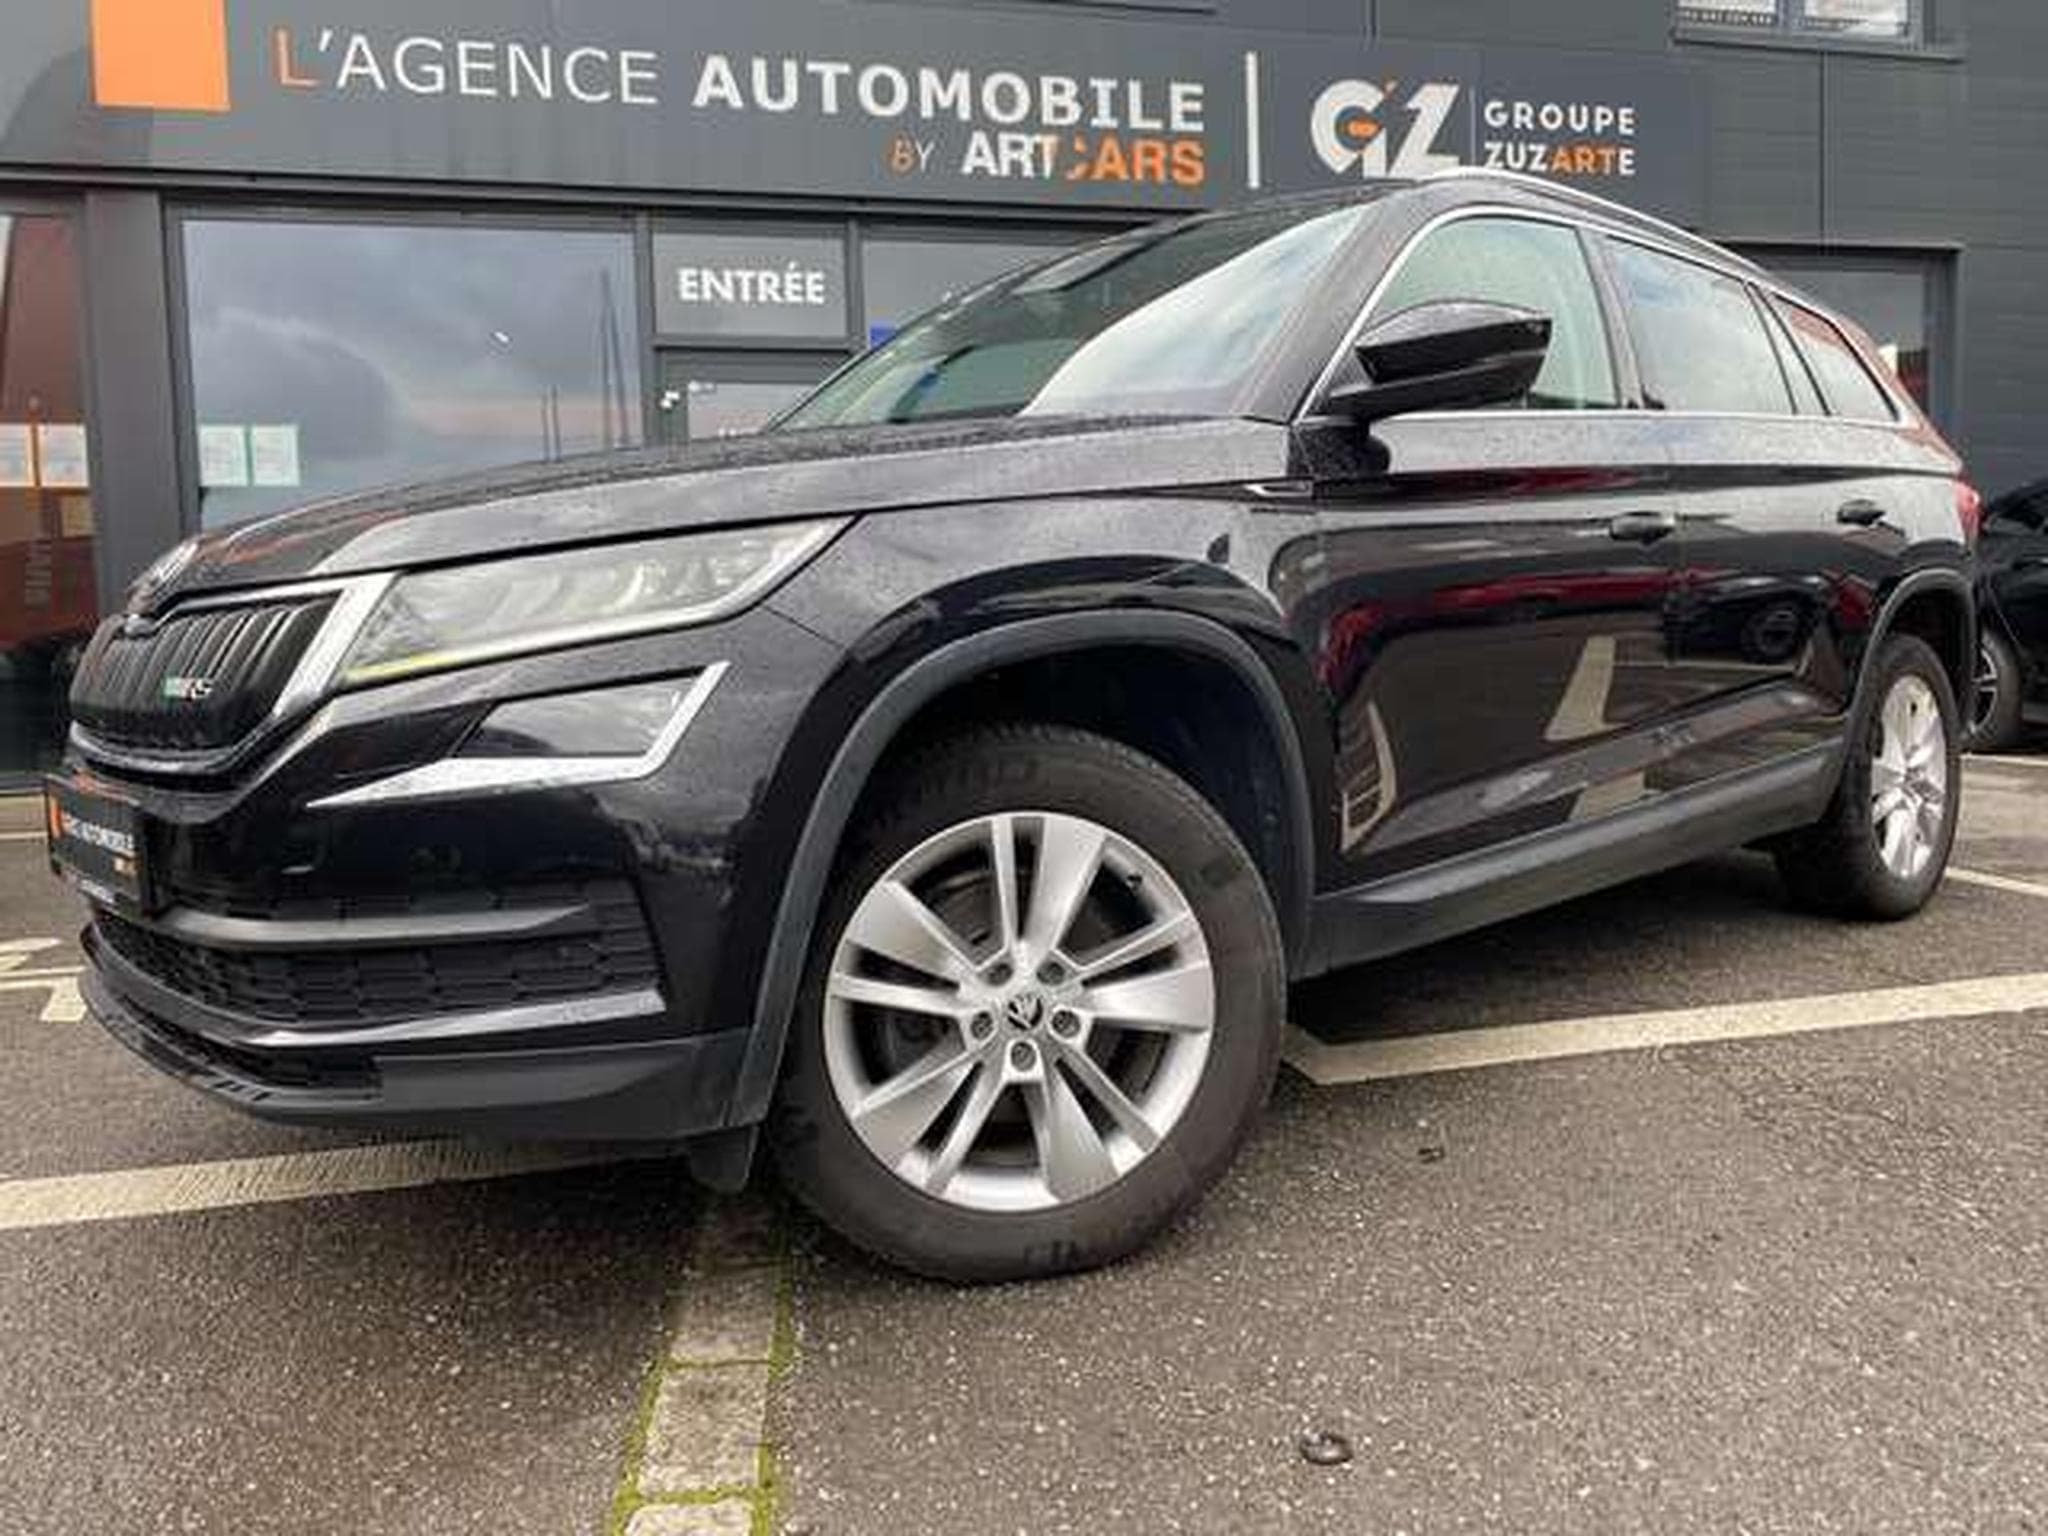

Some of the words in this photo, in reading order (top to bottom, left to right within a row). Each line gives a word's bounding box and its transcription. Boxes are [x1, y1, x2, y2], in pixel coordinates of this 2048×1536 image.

[272, 29, 658, 104] L'AGENCE
[692, 54, 1205, 132] AUTOMOBILE
[1484, 101, 1636, 135] GROUPE
[890, 135, 935, 173] BY
[1484, 141, 1636, 175] ZUZARTE
[677, 261, 825, 303] ENTRÉE
